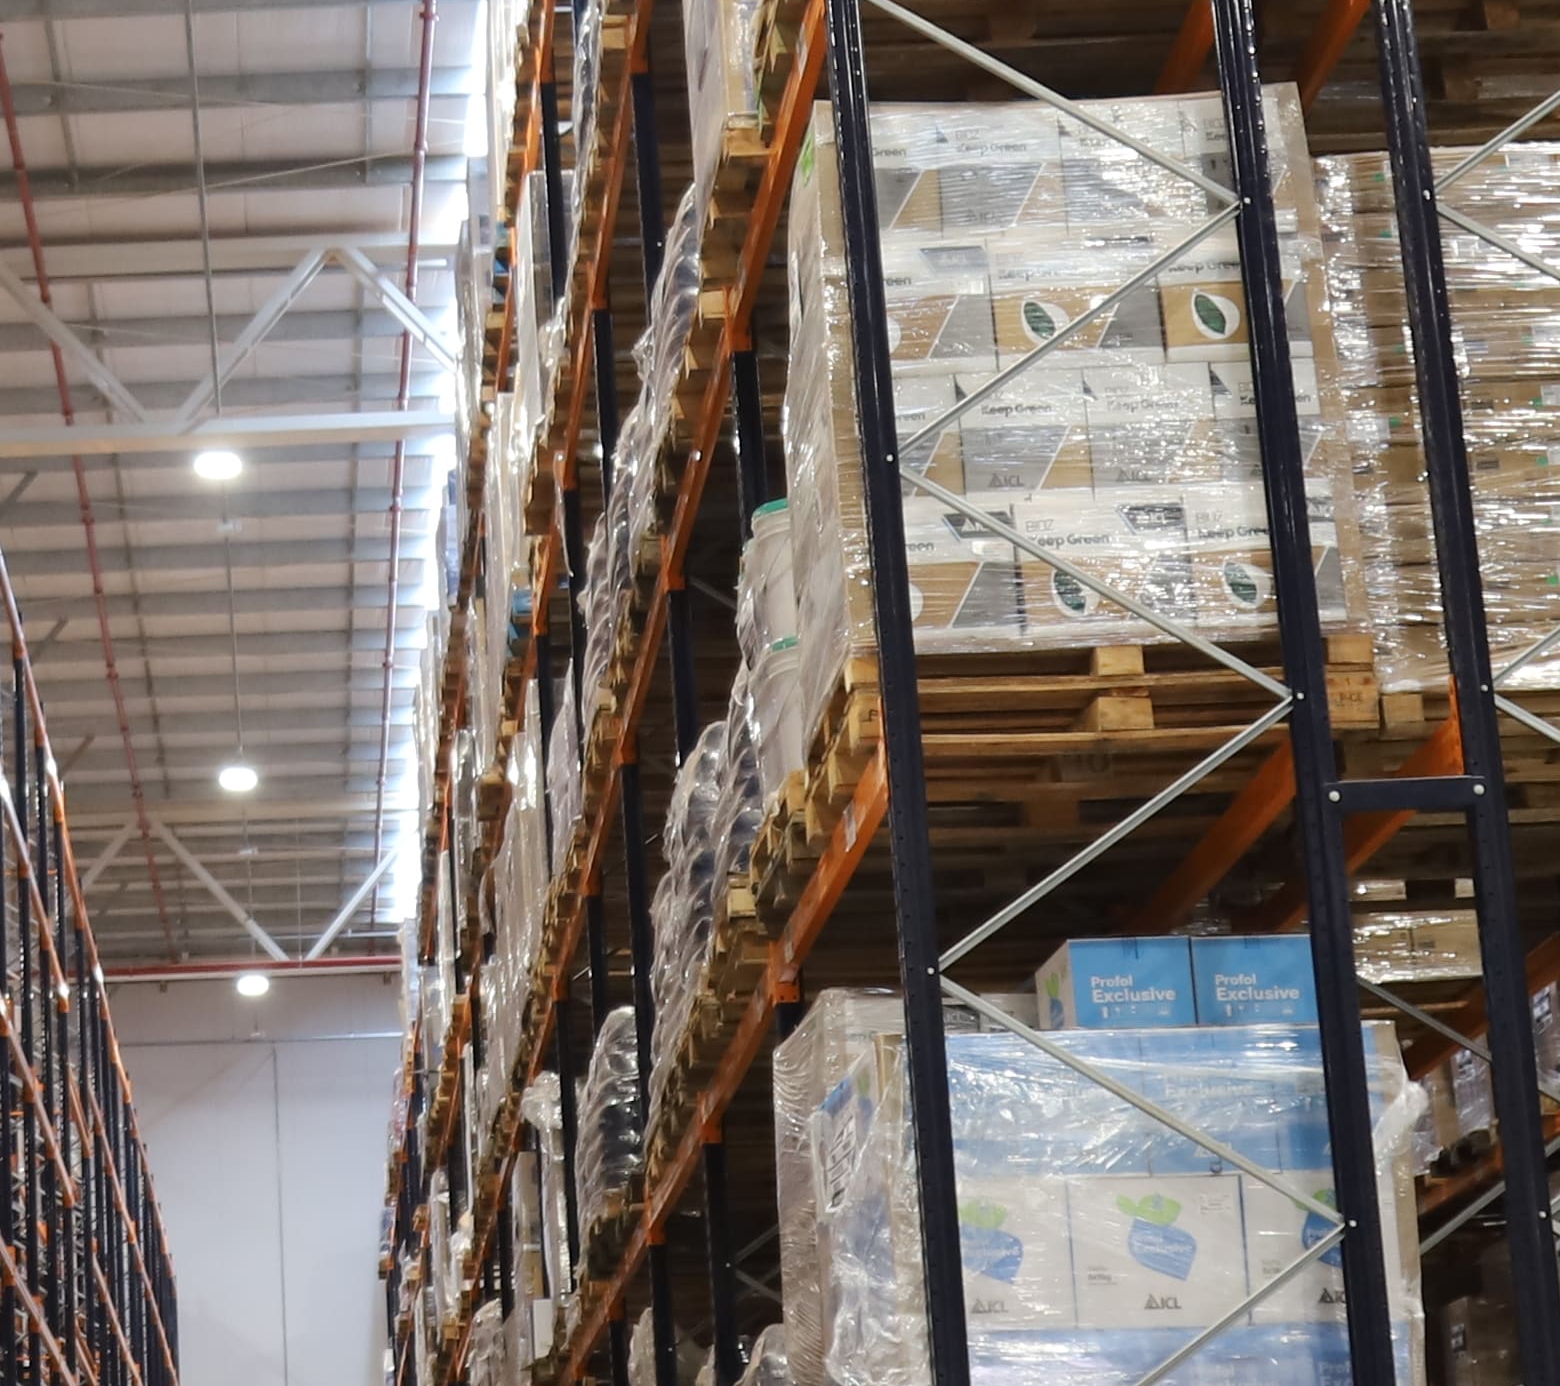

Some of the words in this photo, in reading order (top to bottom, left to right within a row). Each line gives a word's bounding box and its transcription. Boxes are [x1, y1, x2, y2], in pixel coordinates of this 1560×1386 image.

[883, 274, 912, 286] reen
[981, 404, 1013, 417] Keep
[1015, 402, 1052, 414] Green
[896, 412, 925, 422] reen
[905, 540, 934, 551] reen
[1091, 974, 1133, 988] Profol
[1215, 974, 1257, 987] Profol
[1092, 987, 1177, 1004] Exclusive
[1216, 986, 1300, 1002] Exclusive
[1320, 1361, 1351, 1374] Prof
